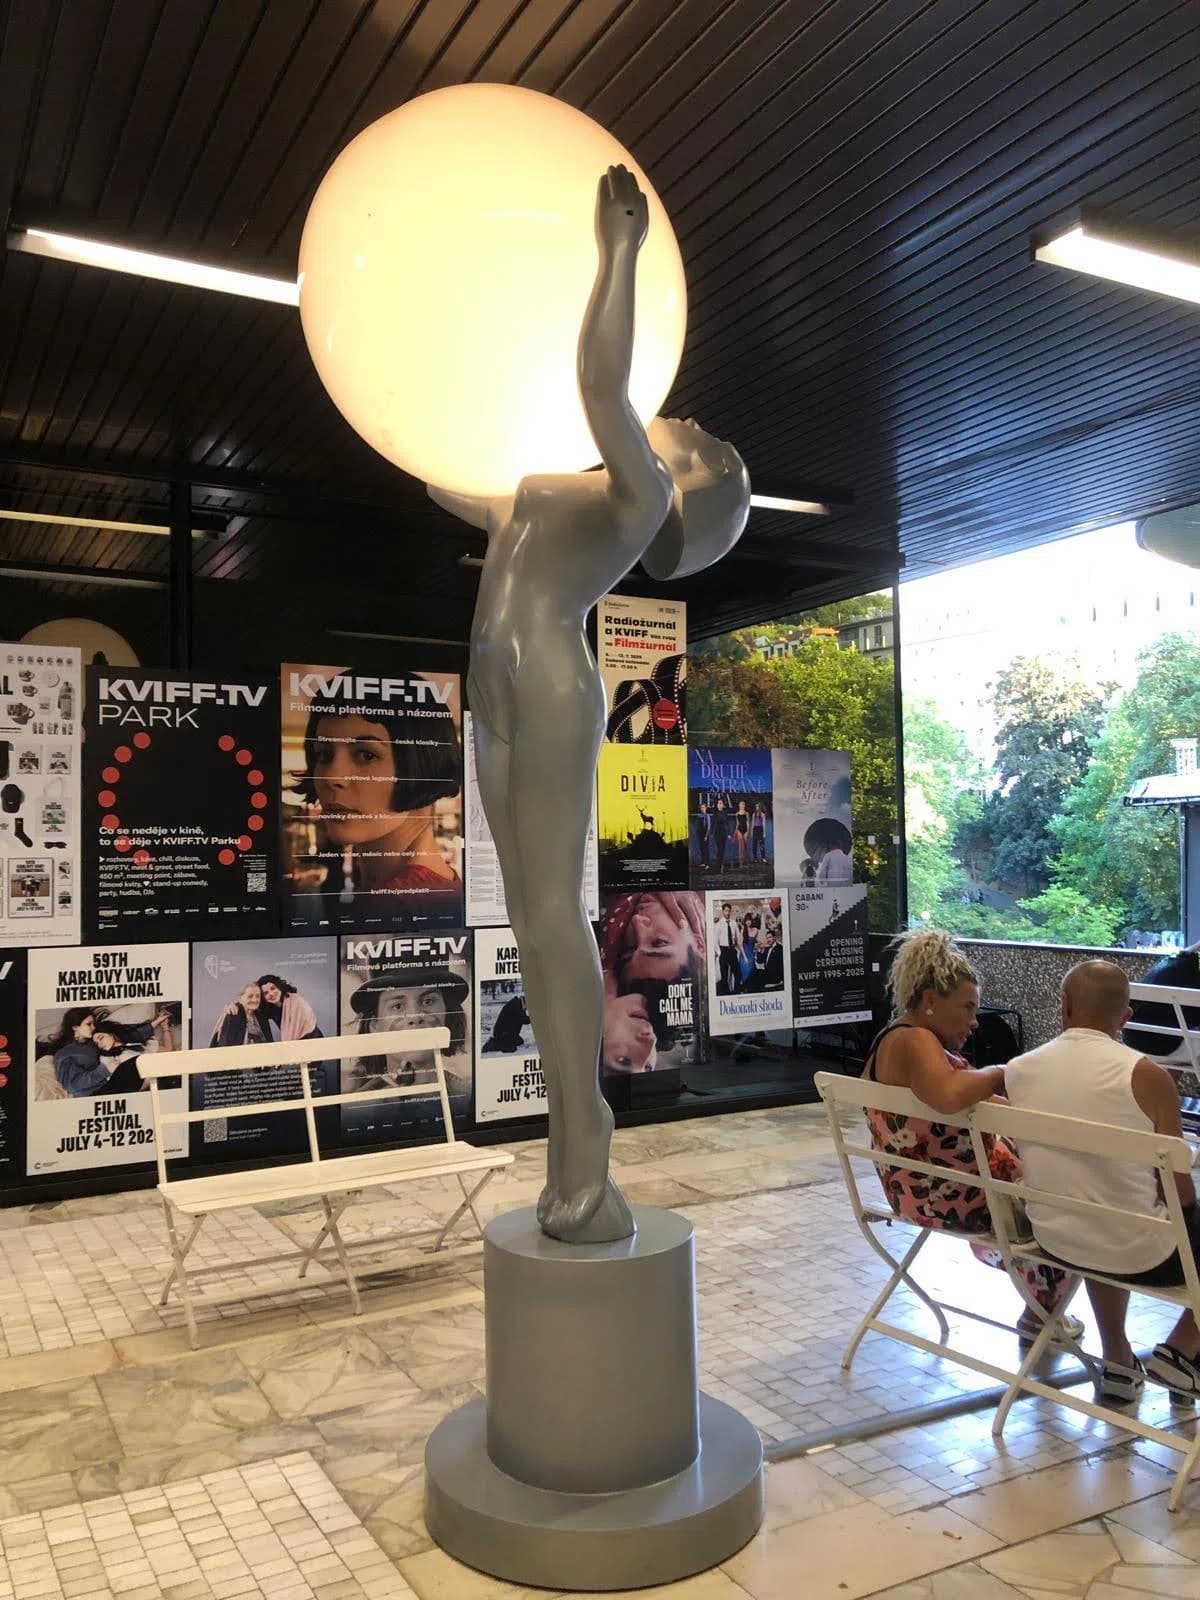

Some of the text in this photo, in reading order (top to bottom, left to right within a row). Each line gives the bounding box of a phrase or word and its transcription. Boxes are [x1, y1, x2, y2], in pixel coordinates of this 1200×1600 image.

[615, 627, 648, 638] KVIFF
[98, 678, 268, 707] KVIFF.TV
[289, 672, 454, 704] KVIFF.TV
[98, 704, 200, 729] PARK
[290, 702, 336, 713] Filmová
[338, 704, 395, 716] platforma
[406, 707, 453, 719] názorem
[99, 825, 204, 837] Co se neděje v kině,
[99, 837, 111, 846] to
[113, 838, 127, 846] se
[128, 836, 151, 847] děje
[162, 836, 209, 846] KVIFF.TV
[211, 836, 241, 846] Parku
[346, 936, 468, 960] KVIFF.TV
[830, 937, 864, 947] OPENING
[496, 947, 519, 961] KAR
[824, 946, 864, 957] & CLOSING
[93, 952, 128, 969] 59TH
[346, 962, 380, 971] Filmová
[382, 961, 423, 971] platforma
[495, 961, 521, 975] INTE
[815, 955, 865, 968] CEREMONIES
[58, 966, 162, 986] KARLOVY VARY
[798, 971, 821, 981] KVIFF
[56, 982, 164, 1003] INTERNATIONAL
[668, 983, 693, 999] DON'T
[659, 998, 693, 1013] CALL ME
[667, 1011, 694, 1027] MAMA
[497, 1087, 522, 1103] JULY
[93, 1099, 127, 1116] FILM
[78, 1114, 142, 1135] FESTIVAL
[57, 1135, 91, 1154] JULY
[128, 1128, 157, 1145] 202
